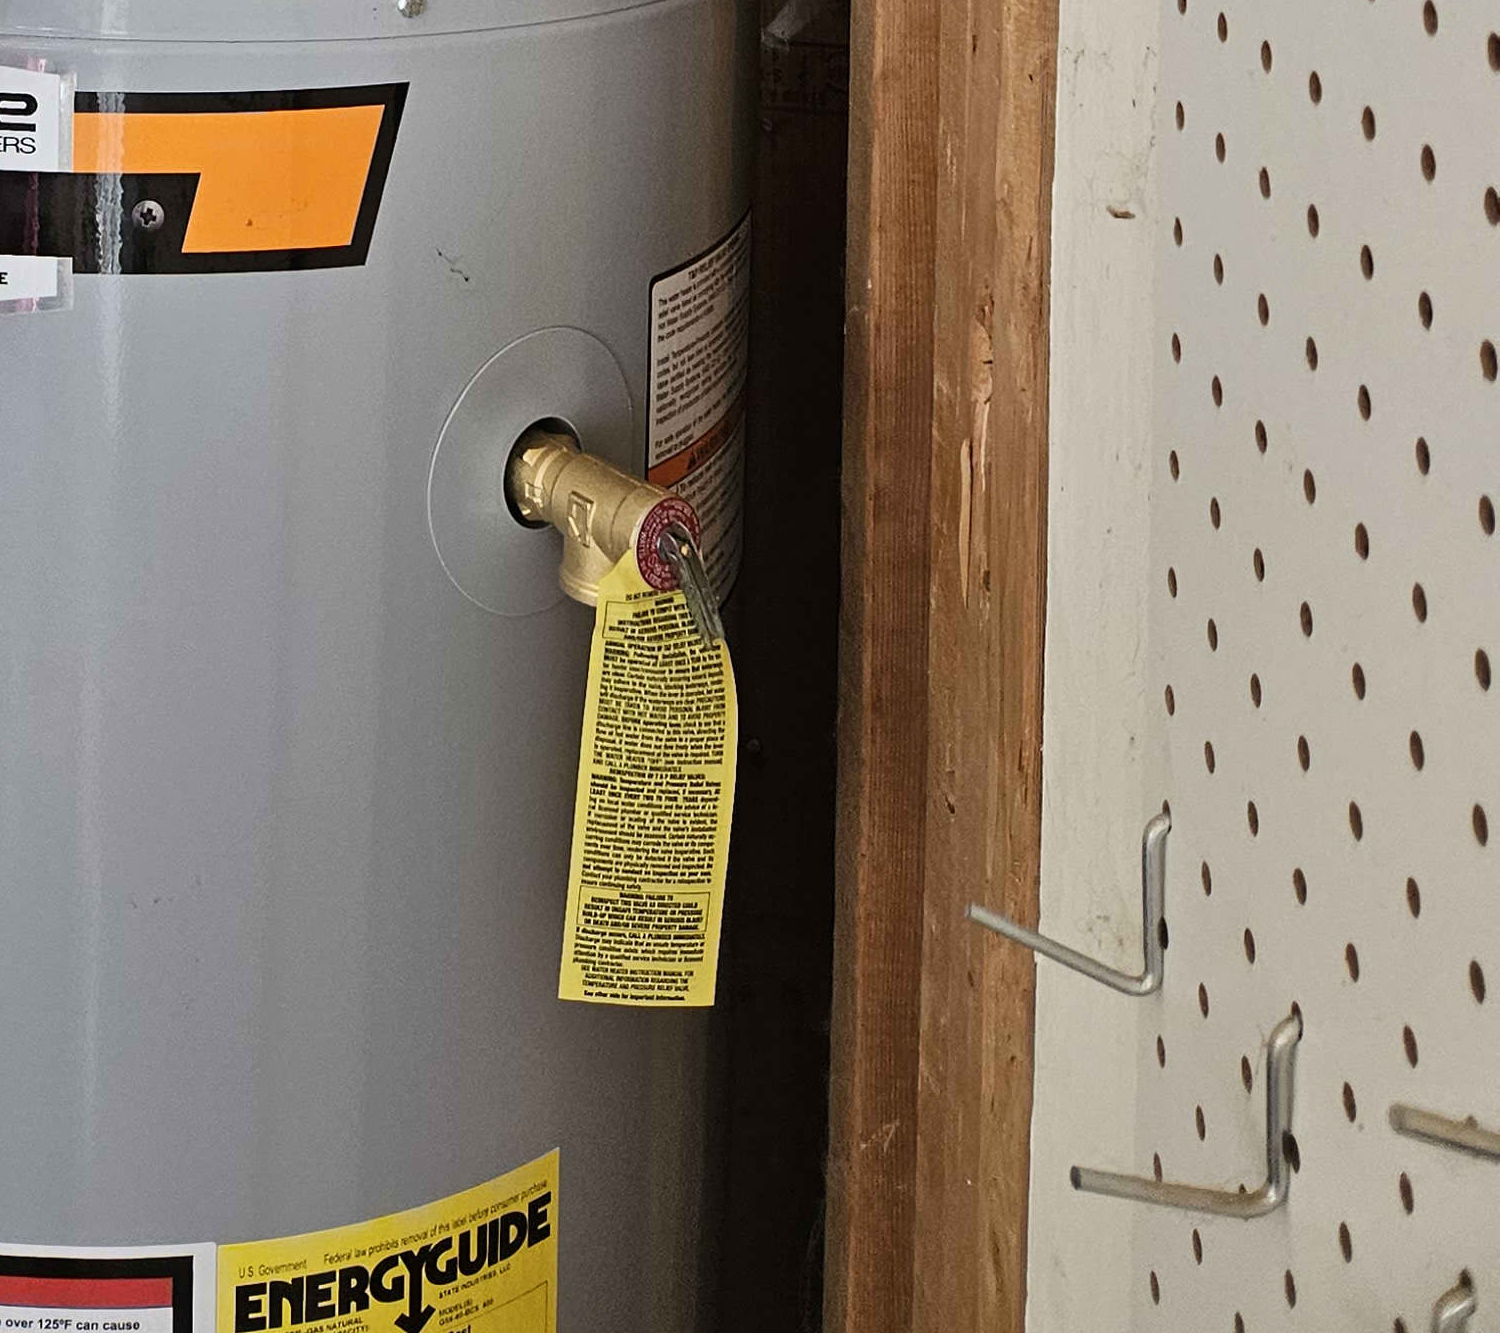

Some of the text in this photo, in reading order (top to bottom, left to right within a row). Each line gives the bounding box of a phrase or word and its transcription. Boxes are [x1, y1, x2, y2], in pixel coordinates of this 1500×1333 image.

[324, 1250, 352, 1265] Federal
[5, 1318, 33, 1329] over
[76, 1321, 98, 1331] can
[102, 1321, 140, 1331] cause
